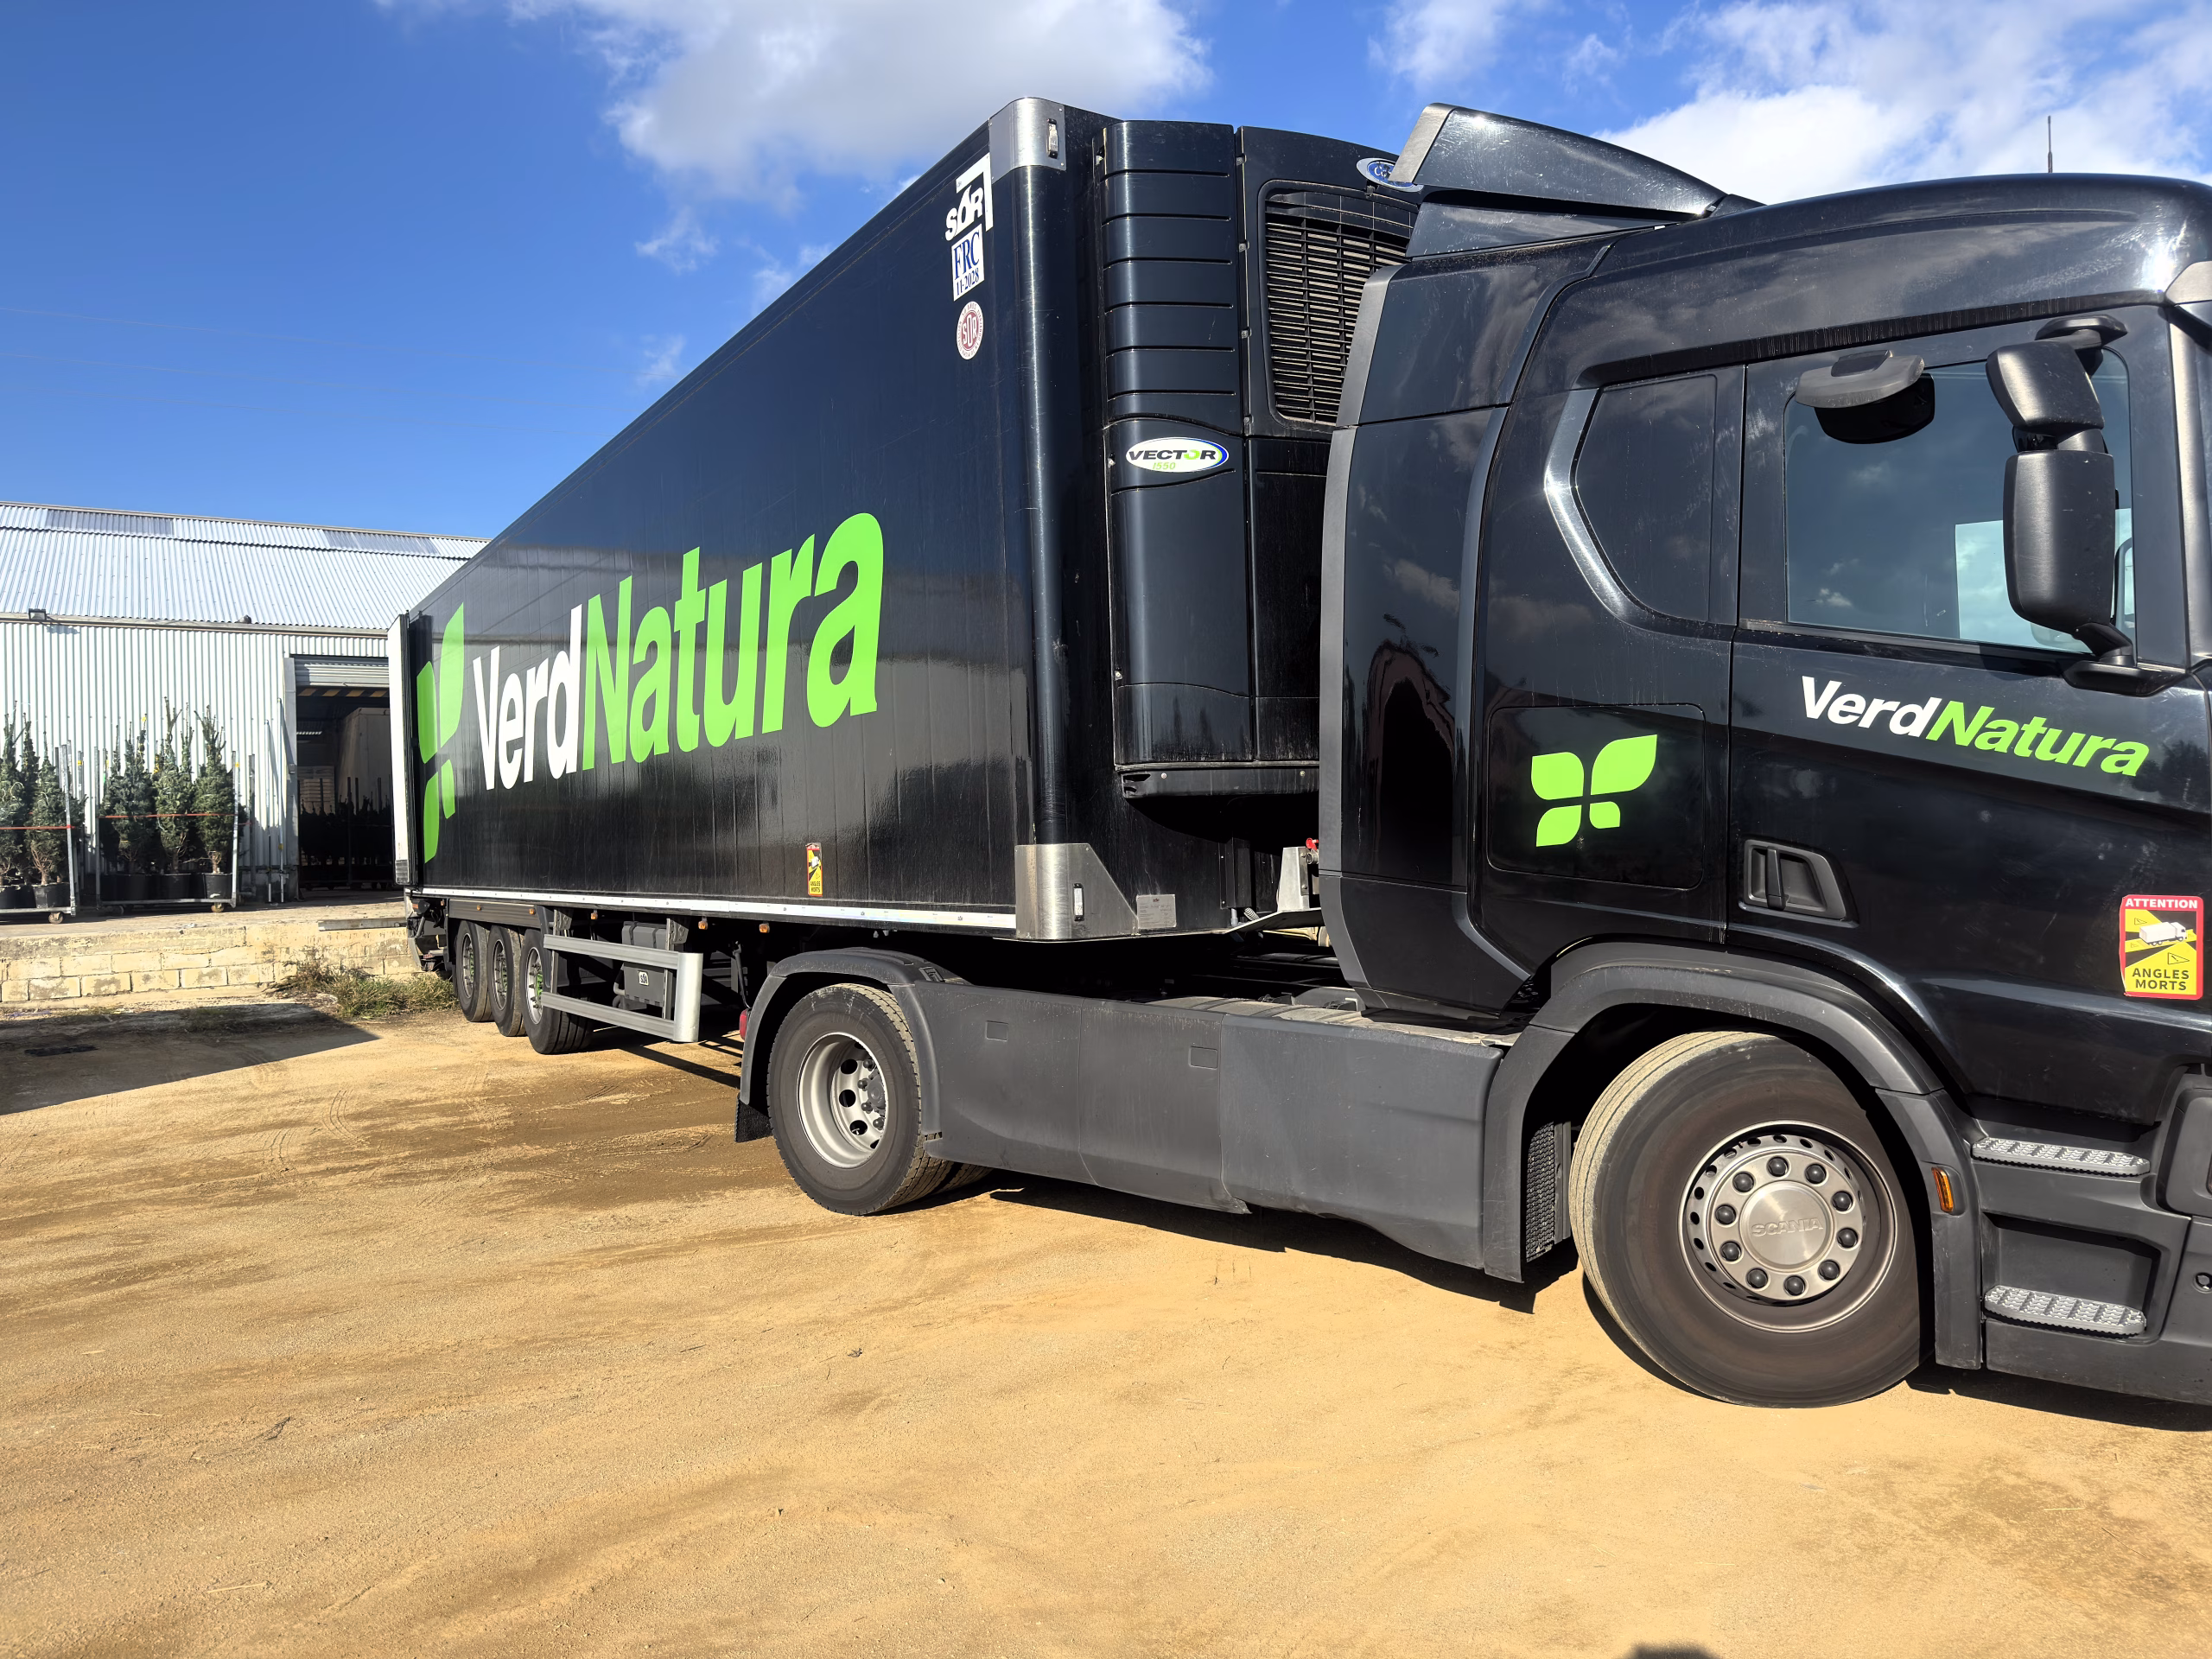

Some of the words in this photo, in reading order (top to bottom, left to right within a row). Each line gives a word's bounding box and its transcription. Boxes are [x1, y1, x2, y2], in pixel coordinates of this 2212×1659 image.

[954, 230, 980, 280] FRC
[957, 268, 980, 296] 11-2028
[1128, 449, 1217, 460] VECTOR
[473, 513, 883, 790] VerdNatura
[1802, 676, 2150, 776] VerdNatura
[2126, 899, 2197, 908] ATTENTION
[2132, 968, 2190, 979] ANGLES
[2135, 979, 2187, 991] MORTS
[1751, 1218, 1823, 1236] SCANIA
